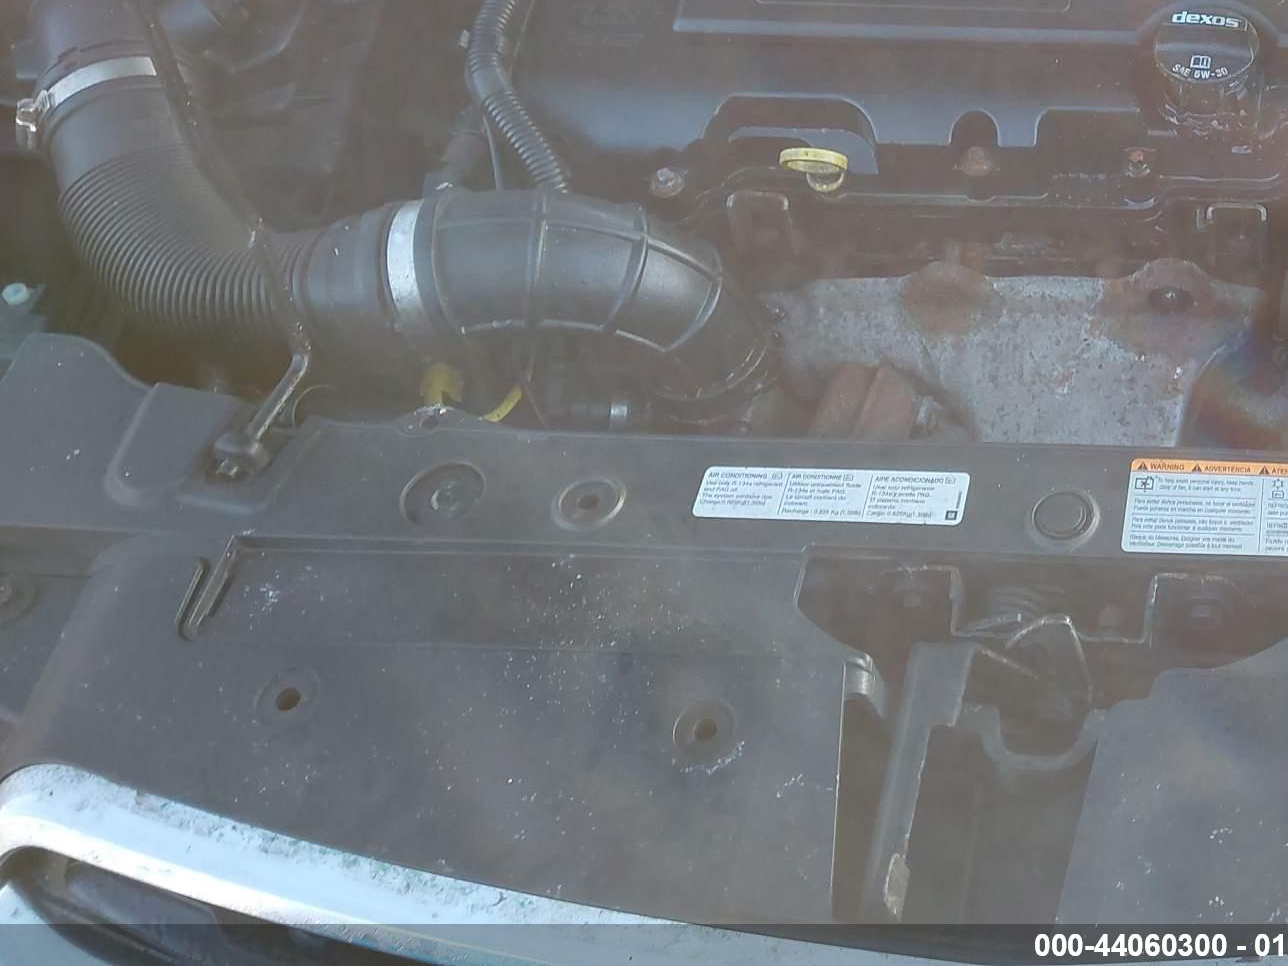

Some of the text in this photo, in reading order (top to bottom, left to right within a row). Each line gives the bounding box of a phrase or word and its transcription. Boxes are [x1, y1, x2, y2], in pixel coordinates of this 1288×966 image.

[1171, 10, 1242, 28] dexos
[1172, 63, 1228, 79] SAE 5W-30
[1150, 462, 1185, 471] WARNING
